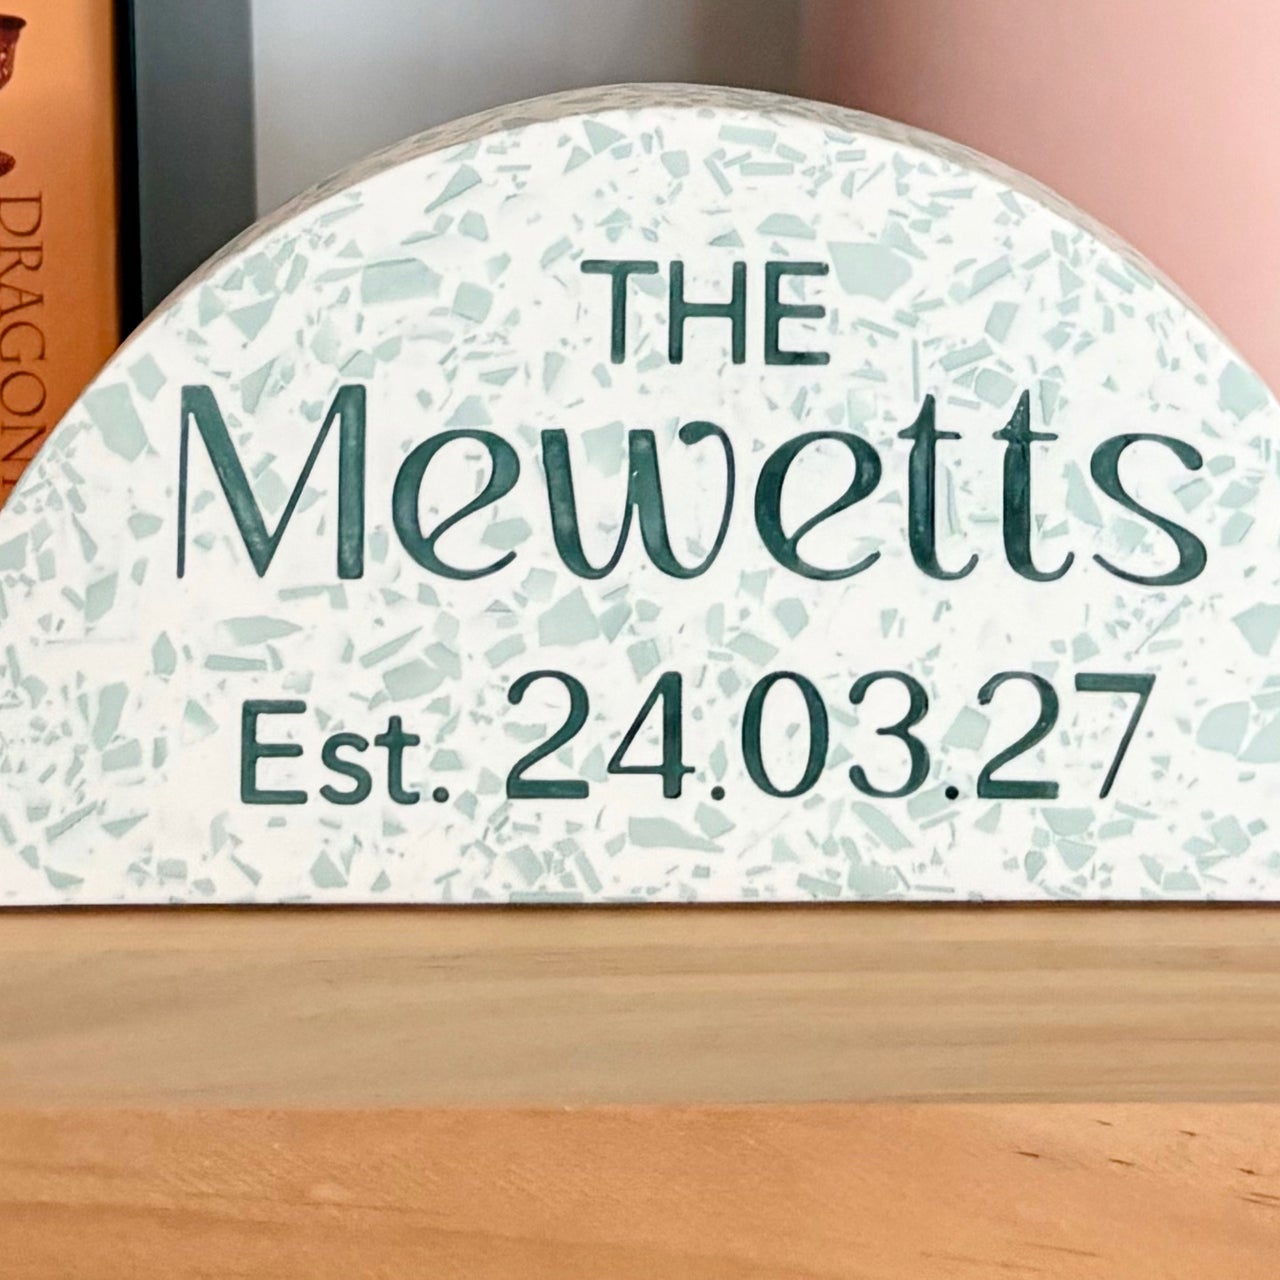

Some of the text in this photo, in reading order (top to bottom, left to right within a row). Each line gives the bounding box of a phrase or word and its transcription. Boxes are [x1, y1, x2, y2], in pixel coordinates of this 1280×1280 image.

[580, 258, 831, 368] THE
[176, 382, 1209, 587] Mewetts
[236, 669, 1158, 807] Est. 24.03.27
